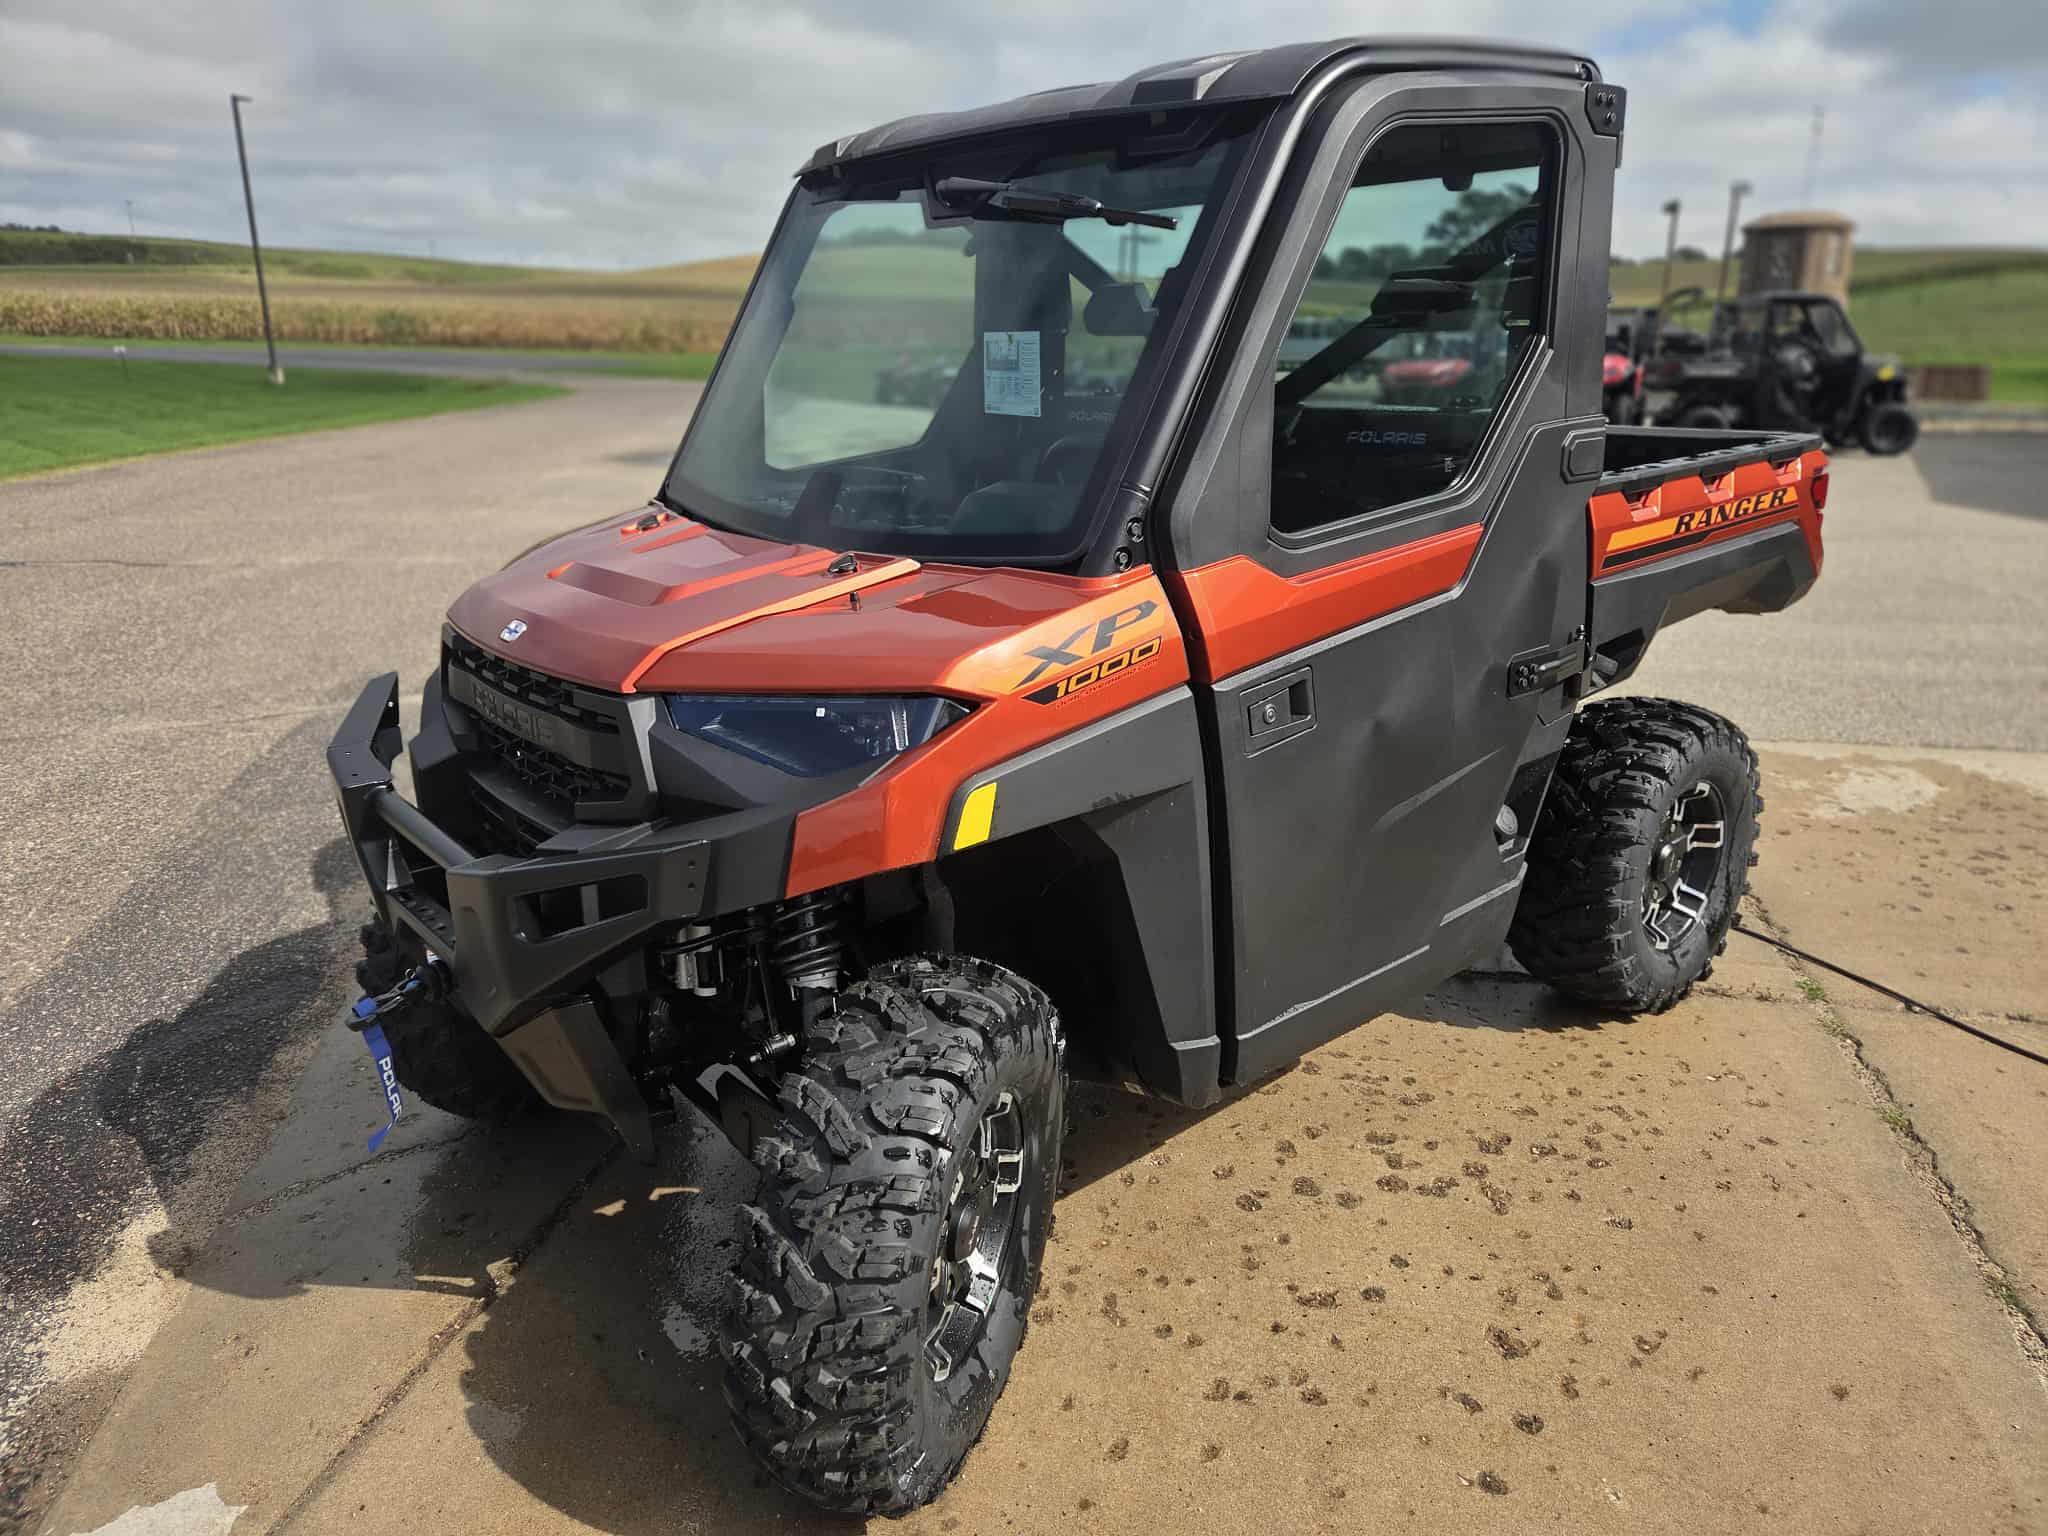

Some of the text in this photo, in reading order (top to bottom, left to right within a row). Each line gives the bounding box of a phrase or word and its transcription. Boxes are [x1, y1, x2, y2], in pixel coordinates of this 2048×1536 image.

[1347, 430, 1427, 444] POLARIS
[1674, 487, 1787, 534] RANGER
[1010, 600, 1158, 690] XP
[1056, 637, 1161, 698] 1000
